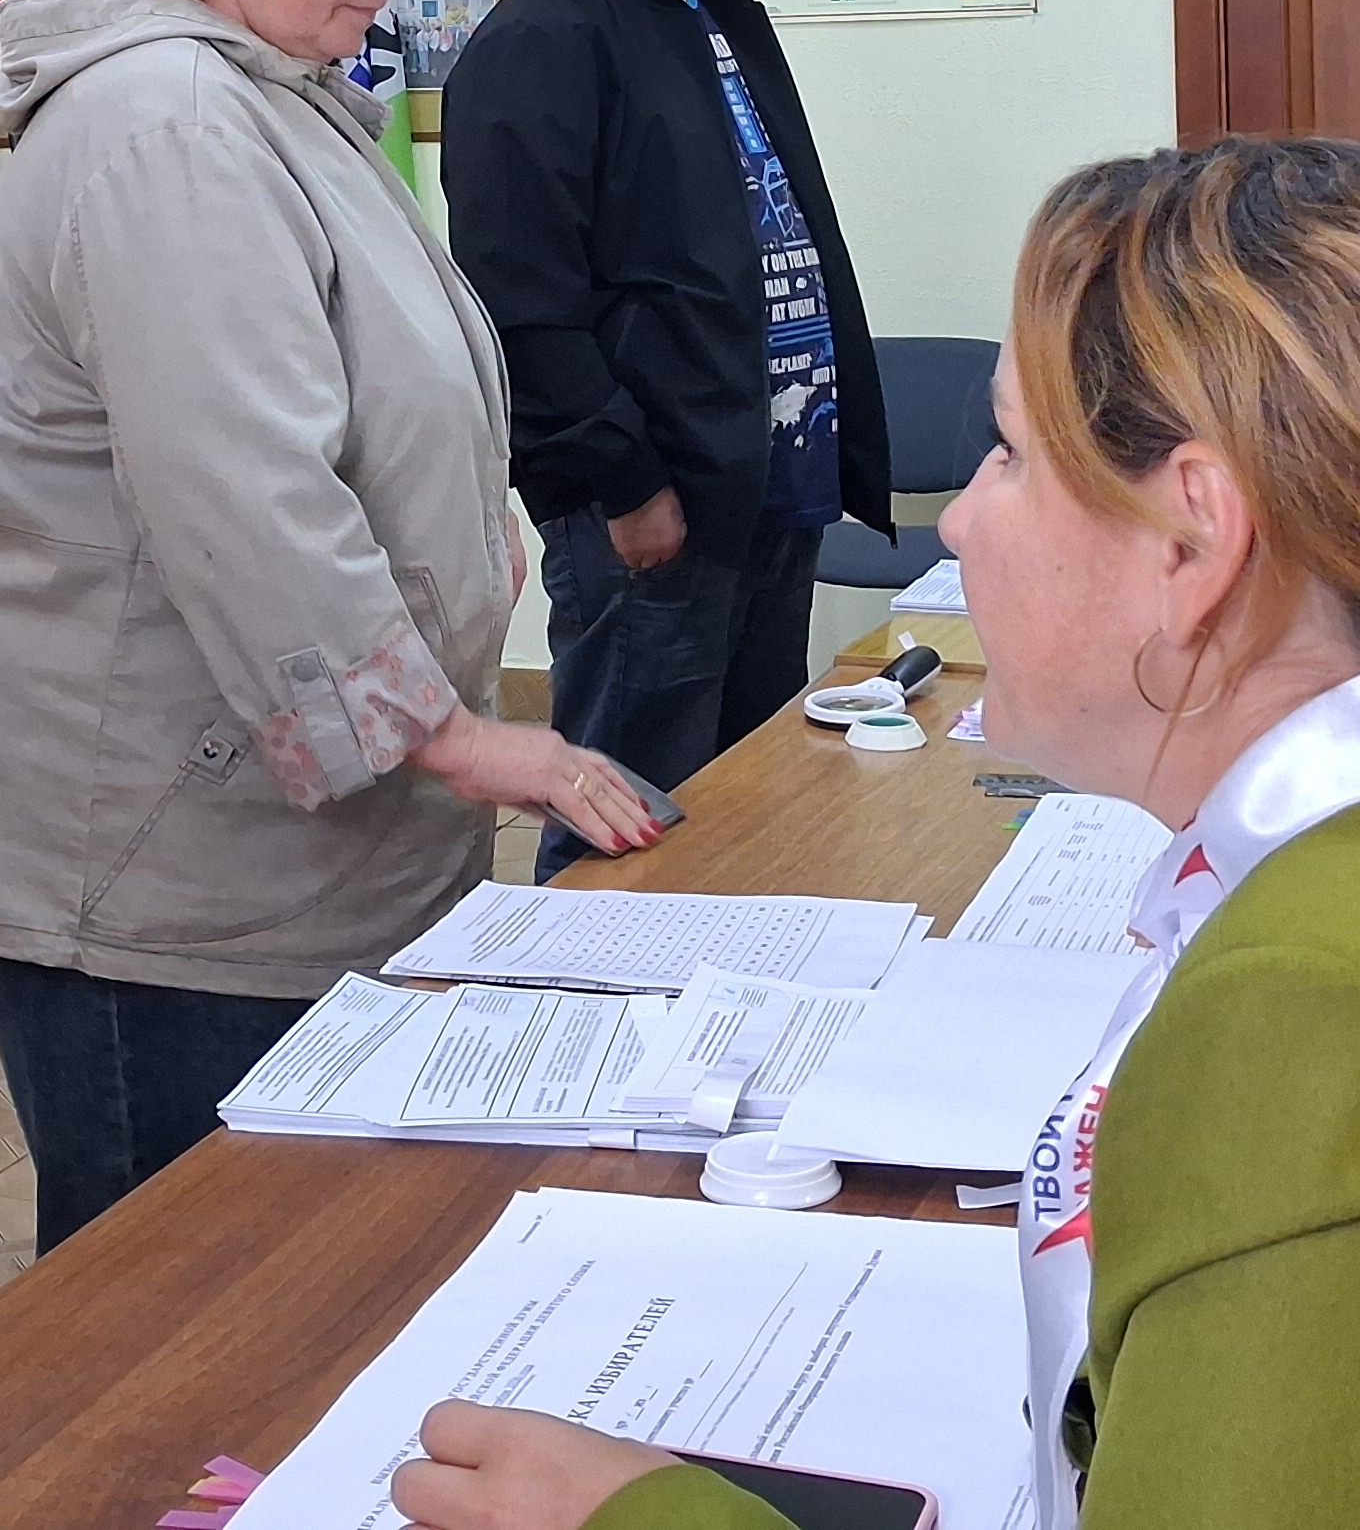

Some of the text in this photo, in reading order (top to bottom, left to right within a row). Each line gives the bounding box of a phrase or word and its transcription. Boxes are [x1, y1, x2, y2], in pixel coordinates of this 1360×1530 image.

[448, 1322, 519, 1397] ГОСУДАРСТВЕННОЙ
[497, 1324, 540, 1371] ФЕДЕРАЦИИ
[585, 1297, 676, 1395] ИЗБИРАТЕЛЕЙ
